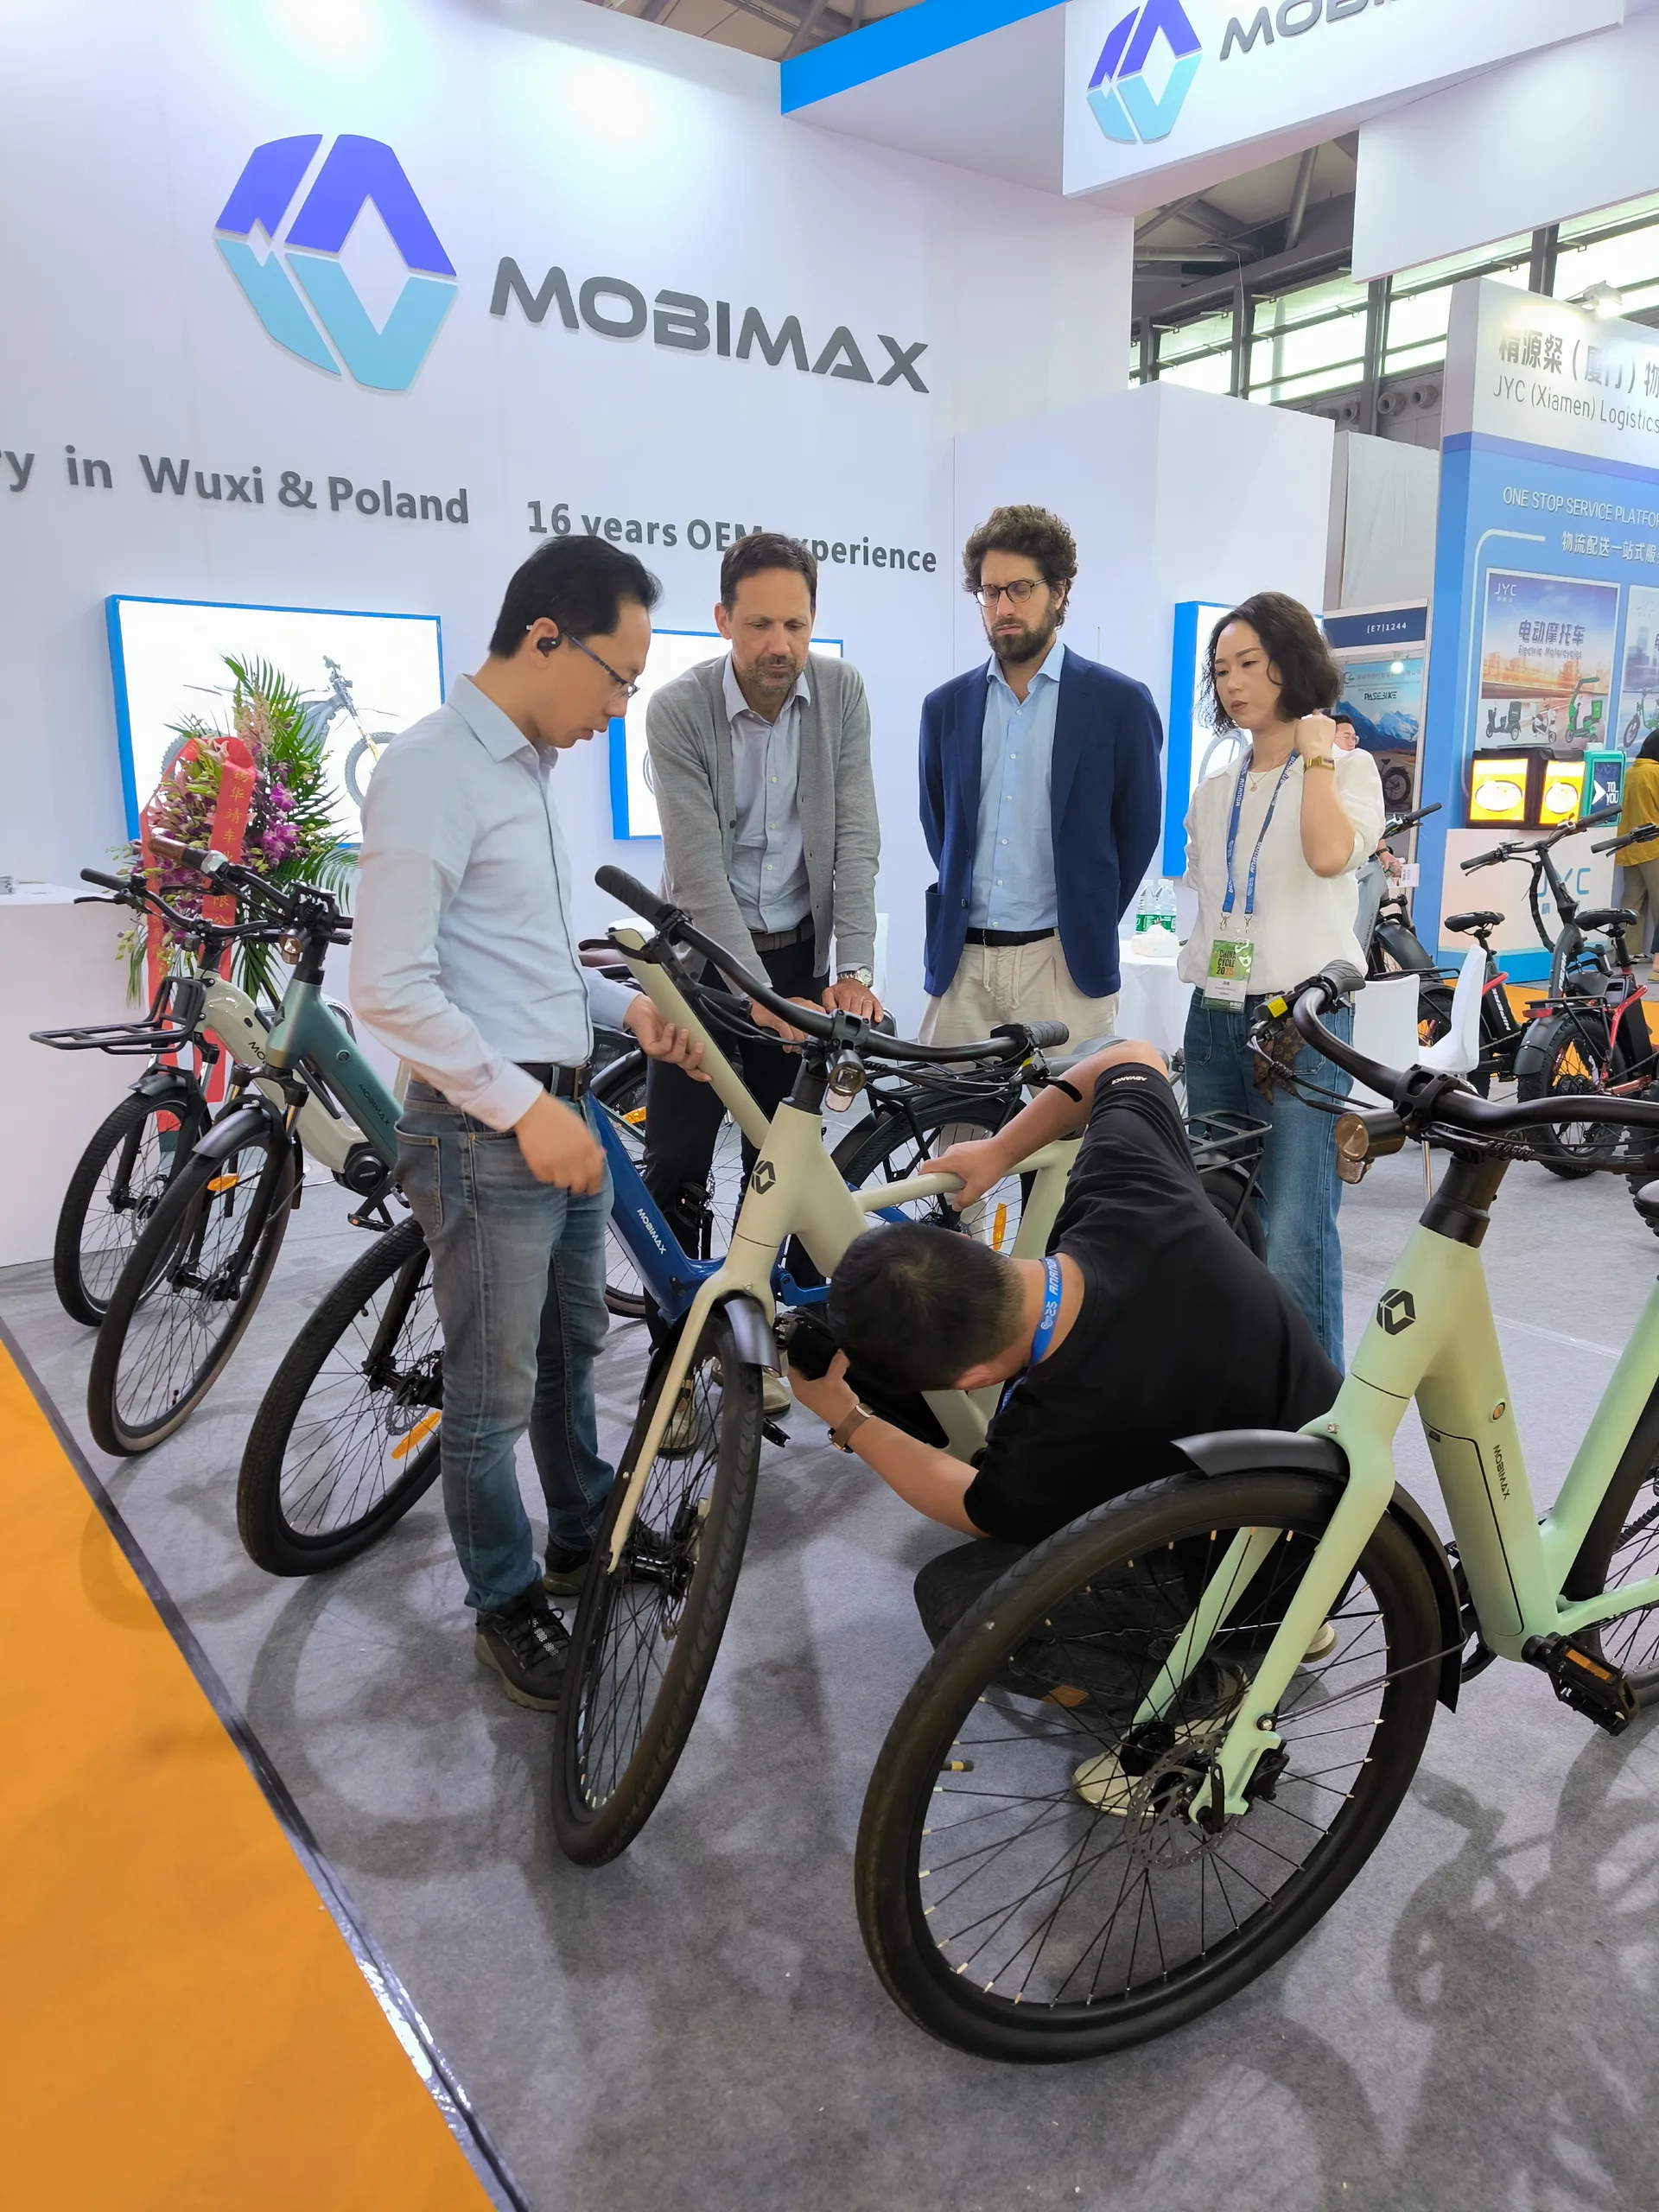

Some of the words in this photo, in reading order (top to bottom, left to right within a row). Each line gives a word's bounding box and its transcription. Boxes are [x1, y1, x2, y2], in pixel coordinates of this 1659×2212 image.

[489, 257, 929, 393] MOBIMAX
[1493, 375, 1525, 403] JYC
[1531, 382, 1595, 421] (Xiamen)
[0, 449, 35, 493] y
[65, 444, 113, 489] in
[138, 454, 264, 504] Wuxi
[278, 470, 317, 509] &
[328, 475, 469, 524] Poland
[1503, 486, 1529, 508] ONE
[1532, 491, 1564, 512] STOP
[1566, 497, 1613, 522] SERVICE
[527, 499, 571, 535] 16
[581, 513, 677, 547] years
[1561, 531, 1659, 564] 物流配送一站式服
[1494, 582, 1516, 596] JYC
[1518, 620, 1586, 646] 电动摩托车
[1518, 645, 1543, 657] Electric
[1216, 966, 1234, 976] 2025
[1217, 958, 1236, 968] CYCLE
[1219, 950, 1236, 960] CHINA
[248, 1041, 266, 1064] MO
[1111, 1076, 1147, 1085] ADVANCE
[358, 1084, 391, 1126] MOBIMAX
[637, 1208, 666, 1255] MOBIMAX
[1493, 1444, 1510, 1500] MOBIMAX
